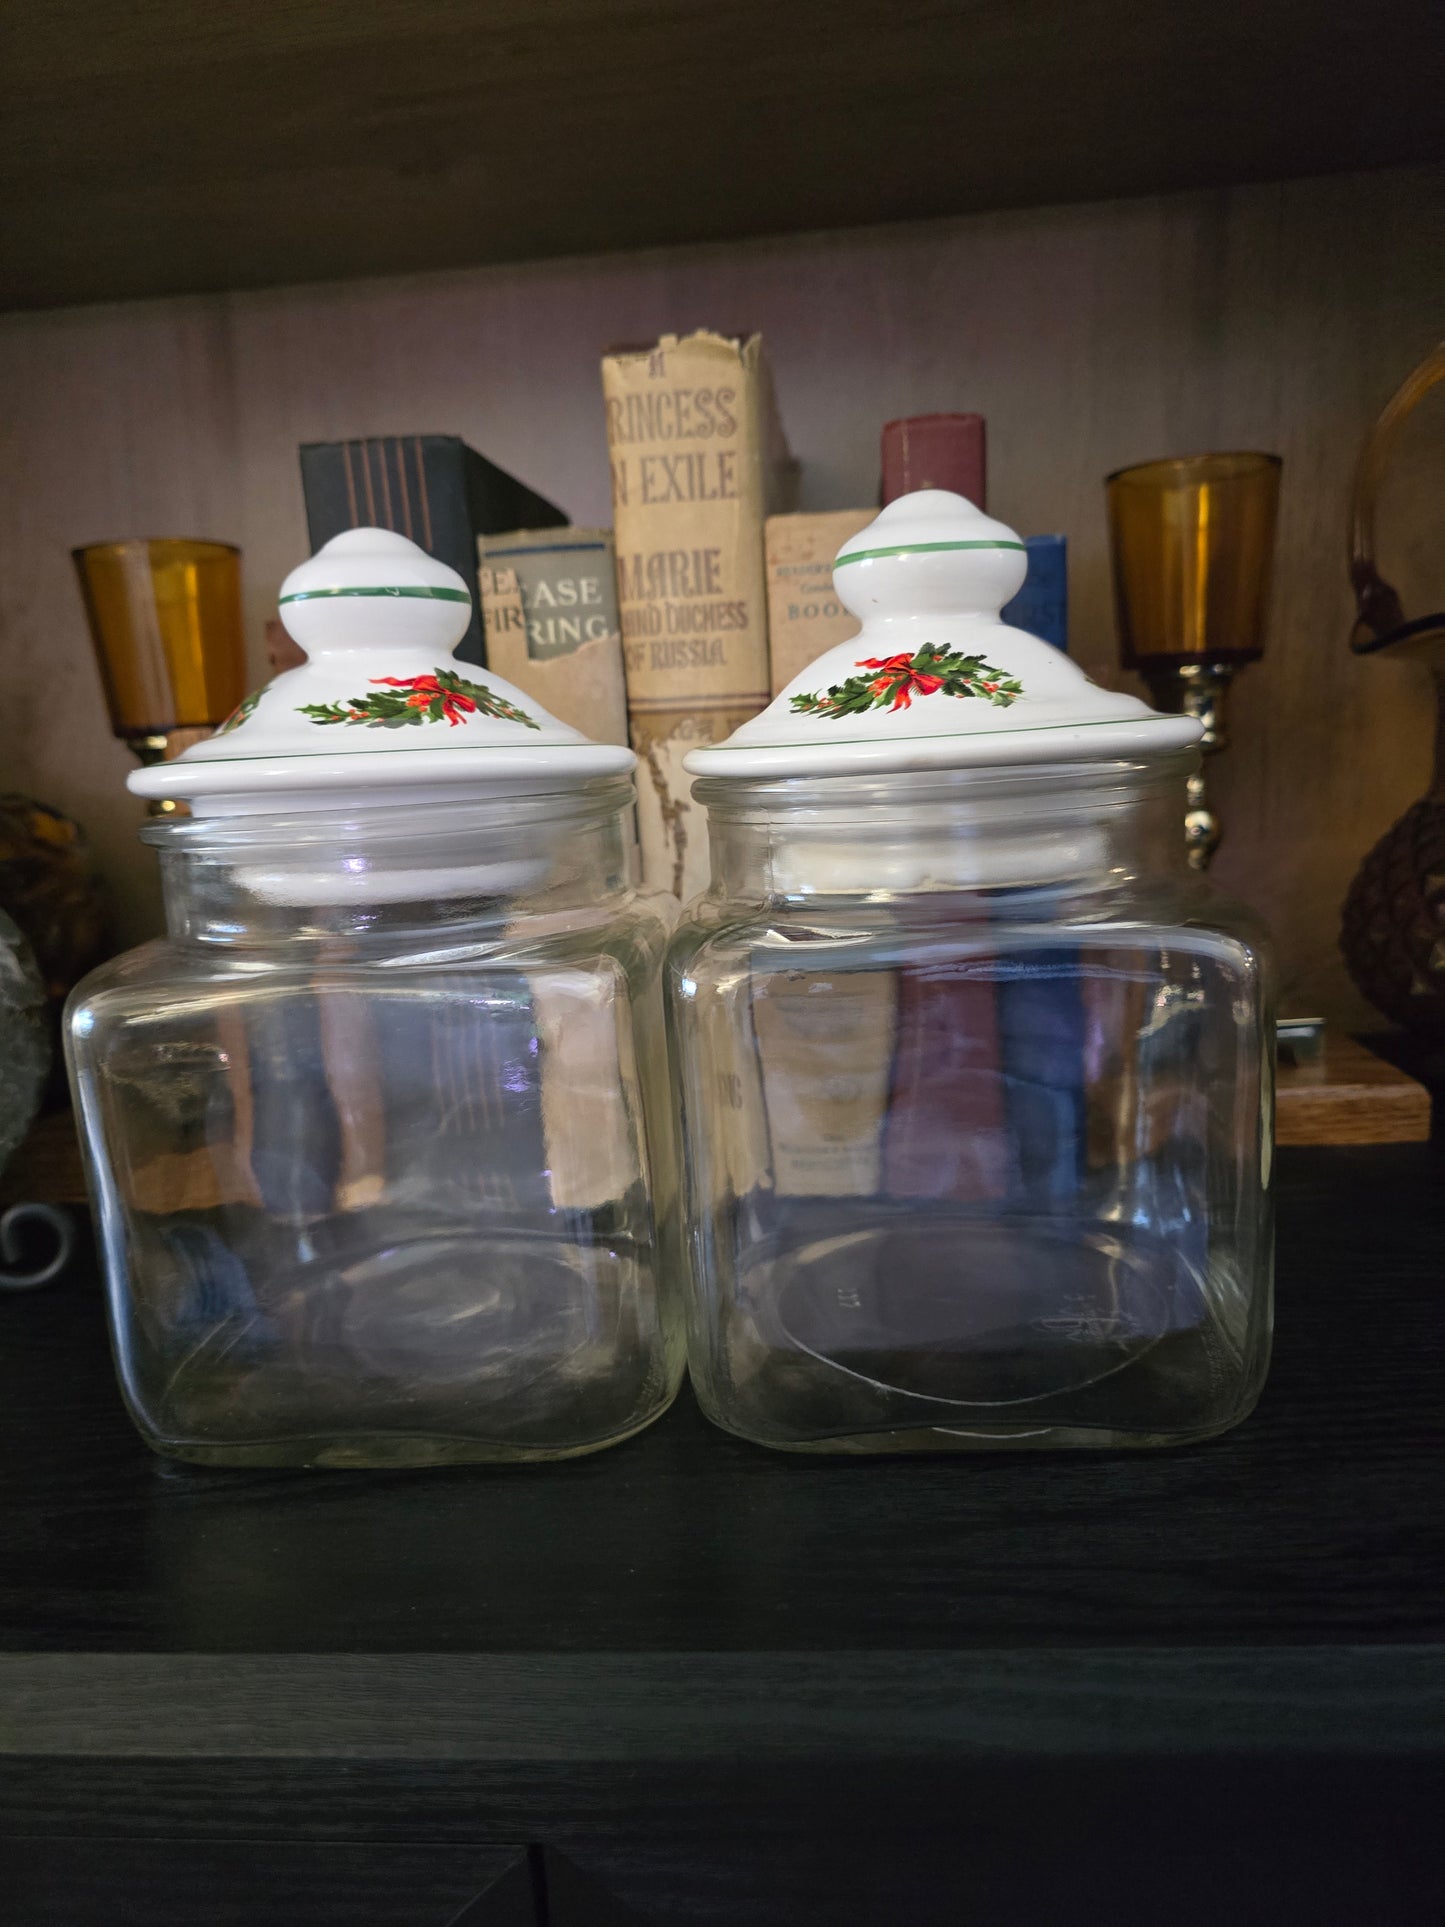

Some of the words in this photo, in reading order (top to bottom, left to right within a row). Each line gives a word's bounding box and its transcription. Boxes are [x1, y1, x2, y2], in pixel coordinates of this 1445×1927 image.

[640, 451, 737, 505] EXILE
[665, 600, 749, 635] DUCHESS
[650, 638, 727, 671] RUSSIA
